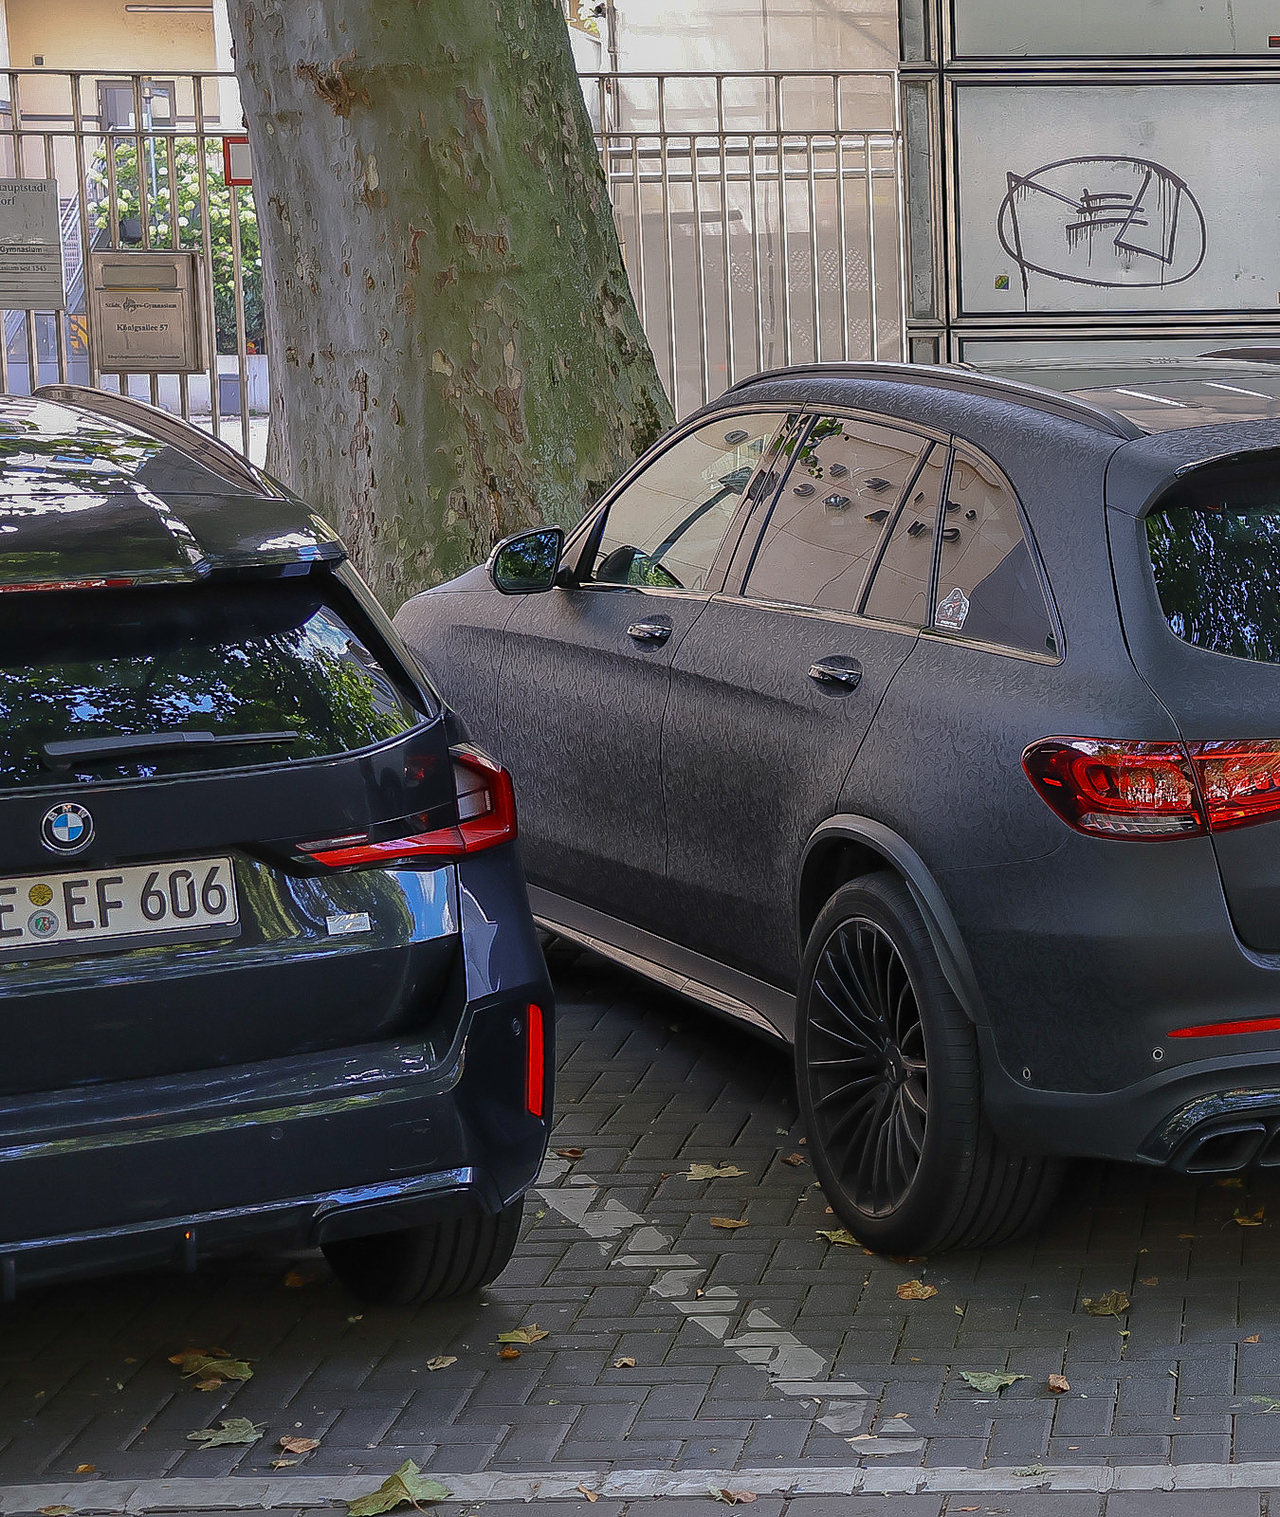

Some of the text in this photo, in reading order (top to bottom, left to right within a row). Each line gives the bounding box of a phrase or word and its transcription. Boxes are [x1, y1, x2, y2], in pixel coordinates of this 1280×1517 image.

[116, 323, 169, 332] Königsallee 57
[48, 804, 89, 822] BMW
[62, 876, 124, 931] EF
[140, 866, 228, 921] 606
